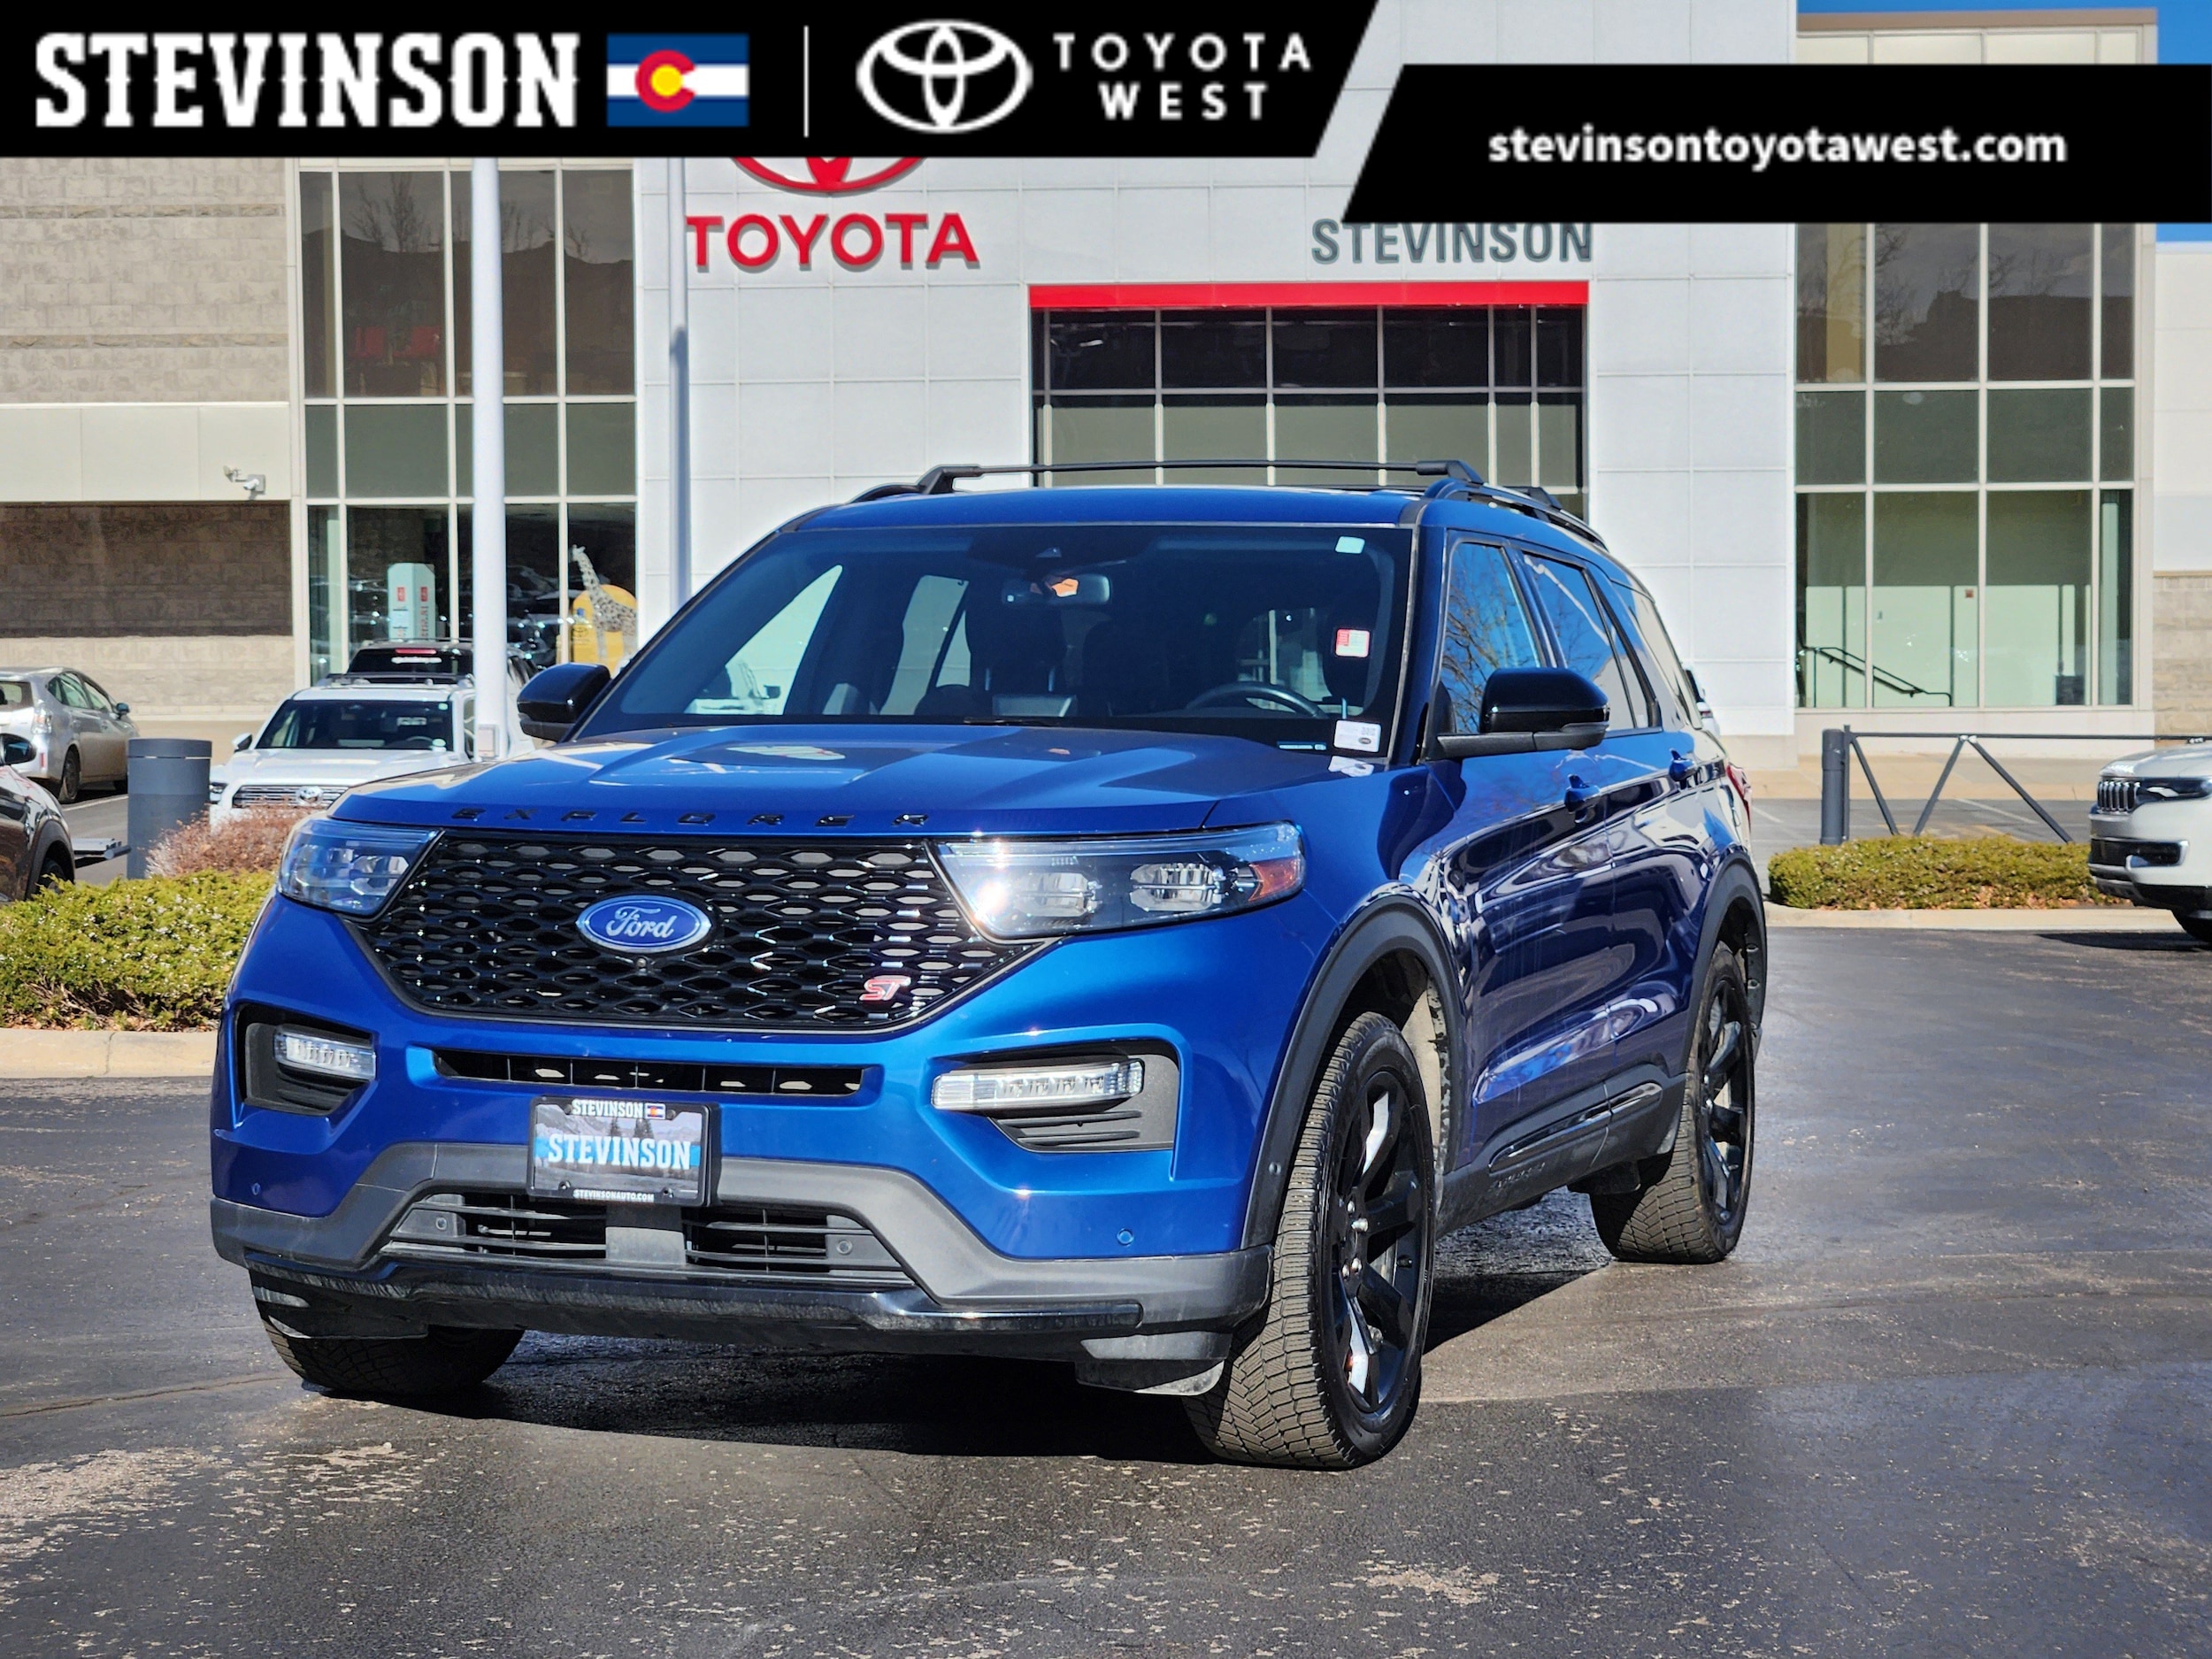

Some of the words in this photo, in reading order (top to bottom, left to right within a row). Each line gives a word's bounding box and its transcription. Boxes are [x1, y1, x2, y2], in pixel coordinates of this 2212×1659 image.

[686, 212, 979, 267] TOYOTA
[1311, 219, 1592, 264] STEVINSON
[451, 808, 929, 827] EXPLORER
[605, 905, 678, 938] Ford
[859, 975, 911, 1001] ST
[572, 1099, 643, 1118] STEVINSON
[548, 1133, 691, 1170] STEVINSON
[573, 1189, 655, 1203] STEVINSONAUTO.COM
